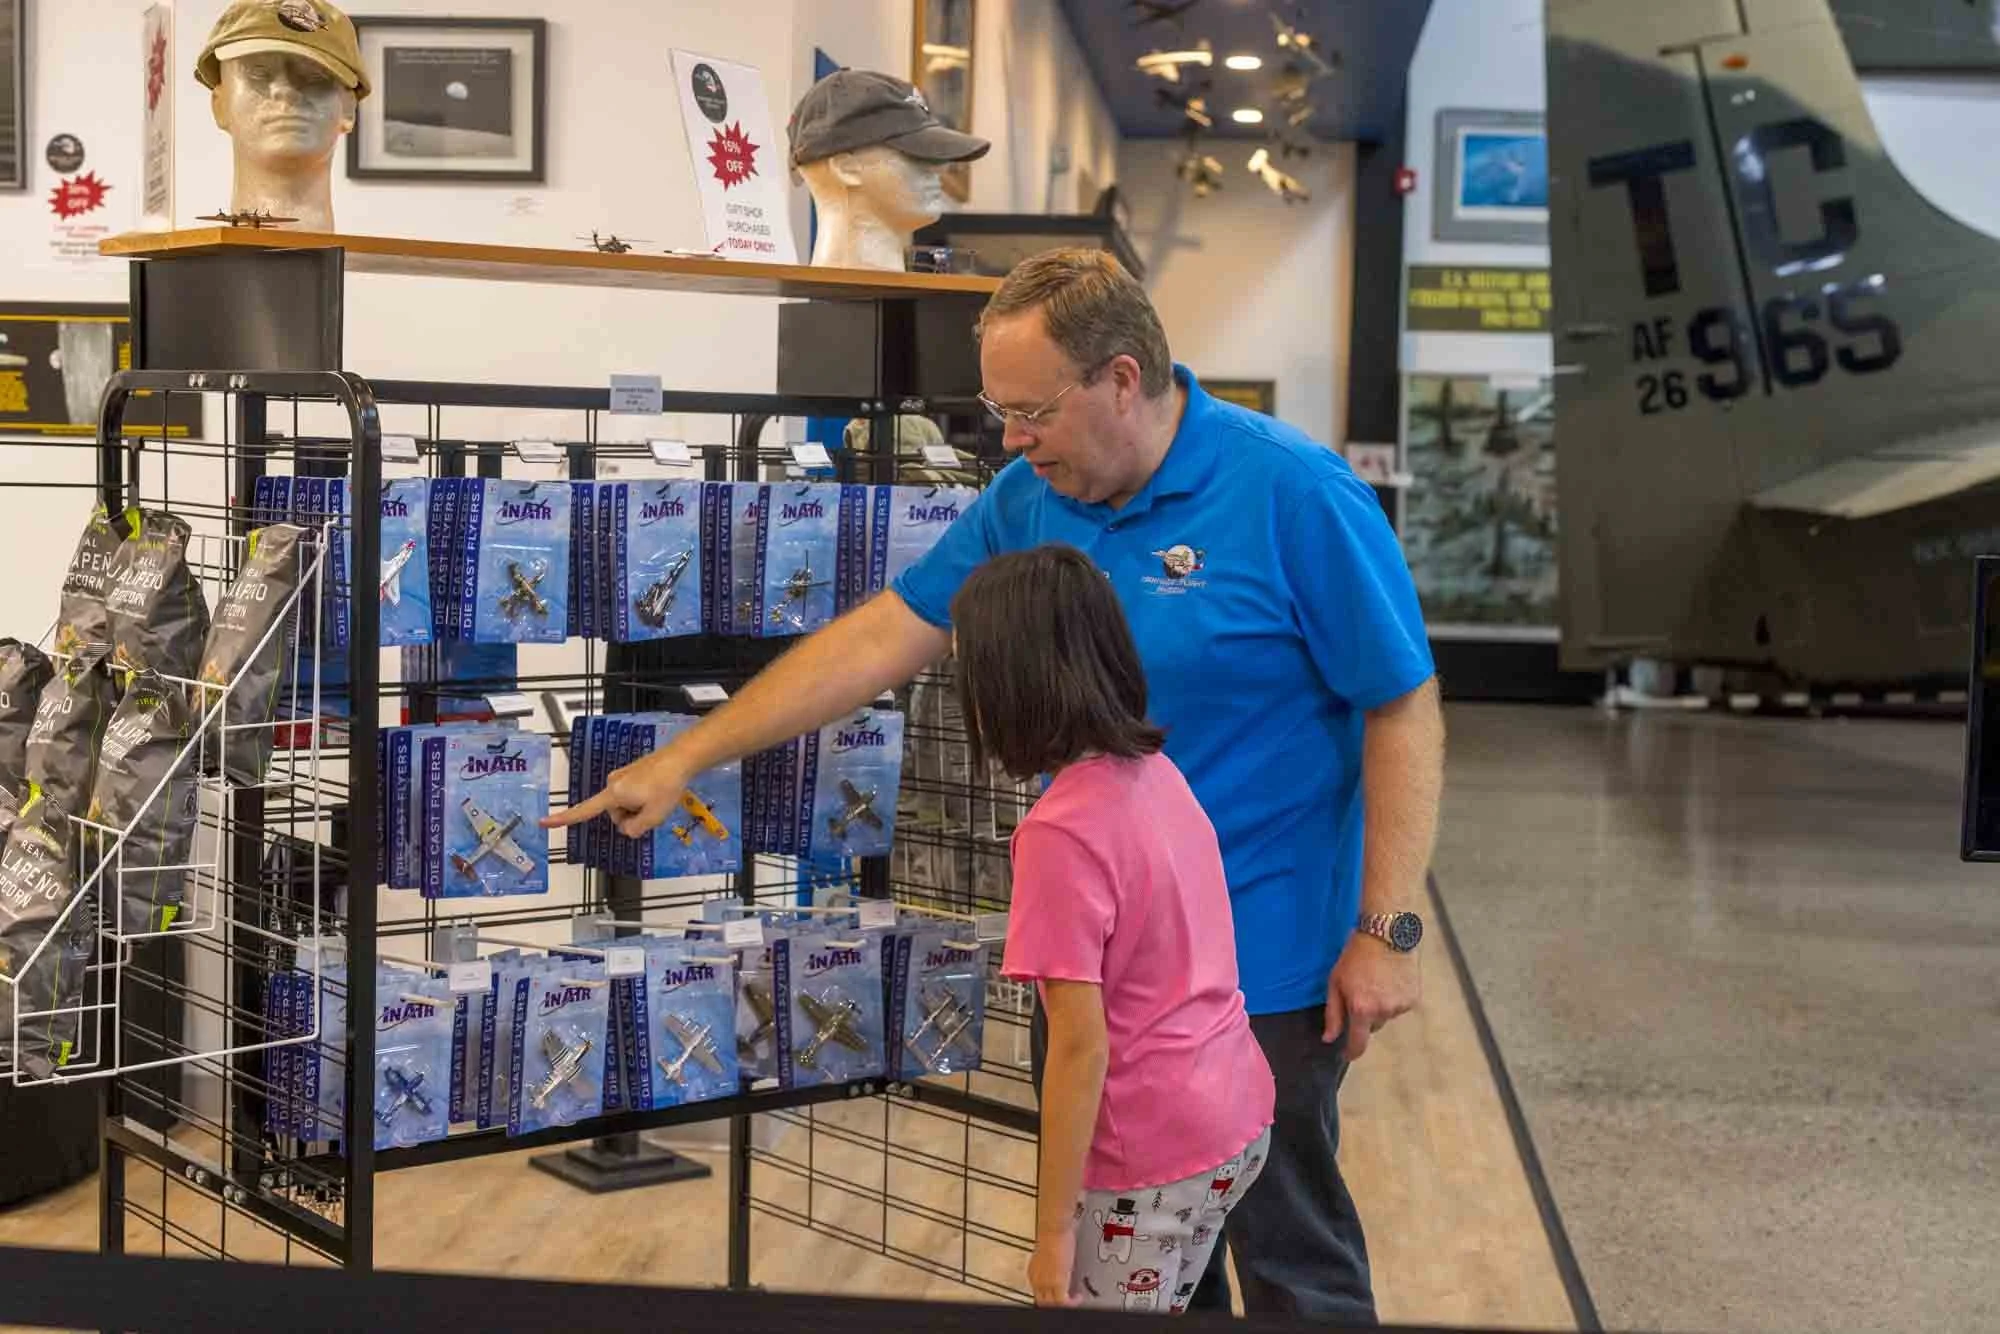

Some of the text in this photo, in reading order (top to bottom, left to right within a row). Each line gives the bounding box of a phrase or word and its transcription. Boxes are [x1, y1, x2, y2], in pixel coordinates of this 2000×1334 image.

[726, 160, 744, 173] OFF
[1631, 316, 1675, 361] AF
[1636, 371, 1689, 415] 26
[296, 493, 307, 523] ERS
[311, 494, 321, 527] ERS
[331, 494, 341, 564] FLYRS
[382, 498, 408, 518] AIR
[720, 500, 729, 551] FLYERS
[71, 551, 112, 571] APEÑ
[435, 491, 456, 624] DIE CAST FLYERS
[463, 492, 480, 628] DIE CAST FLYERS
[617, 498, 626, 628] DIE CAST FLYERS
[66, 572, 105, 590] PCORN
[336, 611, 346, 634] DIE
[721, 602, 729, 622] DIE
[753, 605, 761, 625] DIE
[398, 745, 408, 801] FLYERS
[786, 744, 796, 775] FLYE
[784, 780, 794, 816] CAST
[799, 735, 817, 848] DIE CAST FLYER
[431, 751, 441, 885] DIE CAST FLYERS
[20, 840, 45, 861] REAL
[0, 873, 32, 908] PCORN
[1, 846, 60, 900] LAPEÑO
[295, 990, 305, 1034] YERS
[455, 997, 465, 1037] FLYE
[479, 995, 496, 1115] DIE CAST FLYER
[510, 992, 526, 1122] DIE CAST FLYERS
[635, 977, 650, 1097] DIE CAST FLYER
[305, 1057, 316, 1099] CAST
